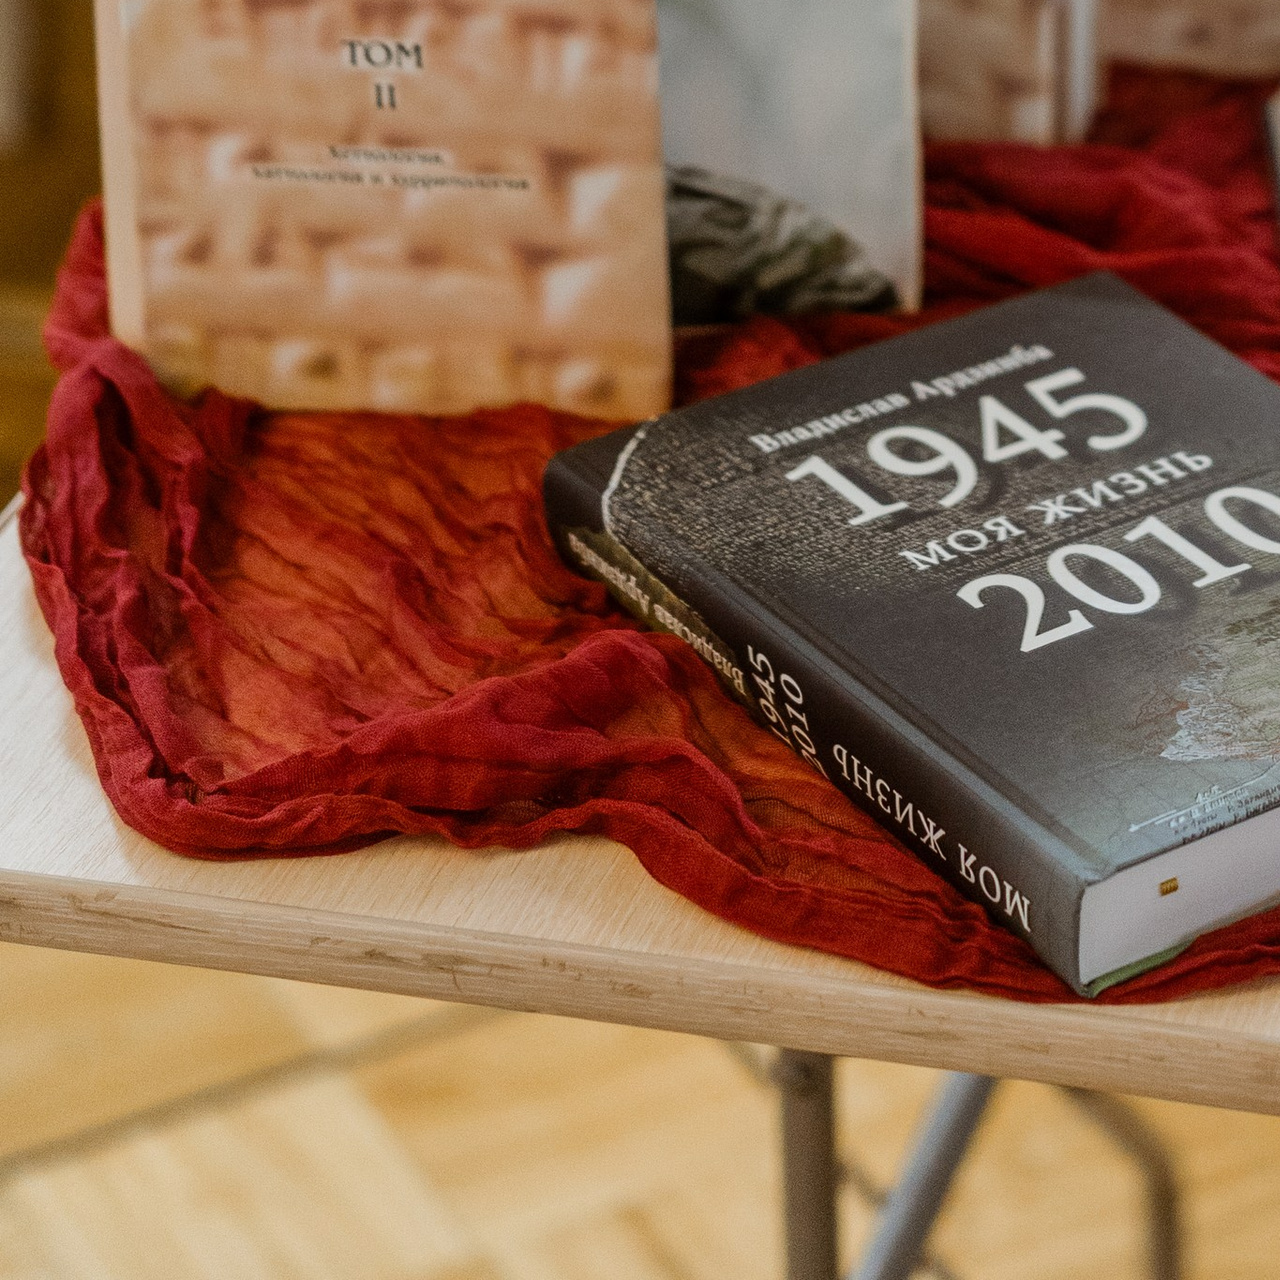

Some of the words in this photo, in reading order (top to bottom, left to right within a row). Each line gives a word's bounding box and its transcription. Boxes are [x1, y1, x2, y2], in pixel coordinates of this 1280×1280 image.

[344, 40, 424, 69] ТОМ
[373, 83, 397, 110] II
[748, 391, 911, 454] Владислав
[784, 366, 1149, 528] 1945
[746, 643, 796, 751] 1945
[832, 743, 947, 861] ЖИЗНЬ
[957, 842, 1032, 934] МОЯ
